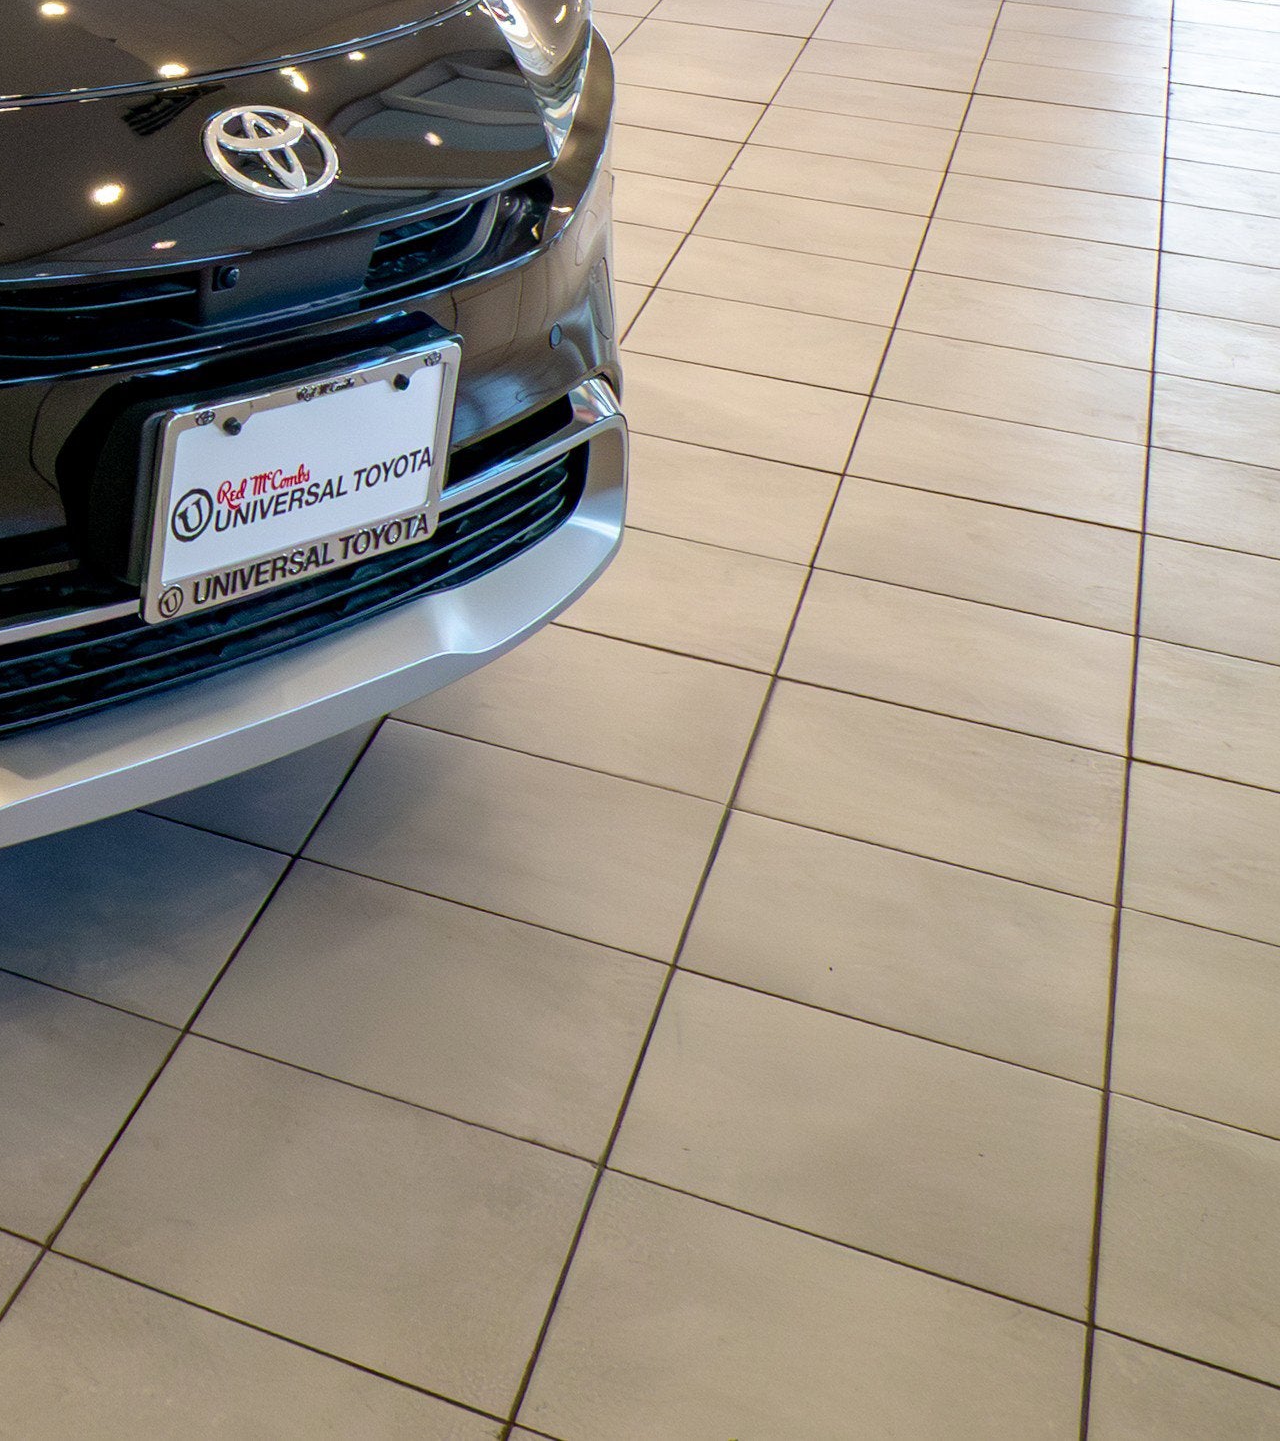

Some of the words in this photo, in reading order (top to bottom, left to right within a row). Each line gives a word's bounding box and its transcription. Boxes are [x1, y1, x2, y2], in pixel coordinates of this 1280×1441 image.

[215, 475, 348, 532] UNIVERSAL
[354, 447, 434, 491] TOYOTA
[217, 479, 247, 510] Red
[251, 464, 310, 496] McCombs
[194, 542, 335, 604] UNIVERSAL
[339, 513, 429, 559] TOYOTA
